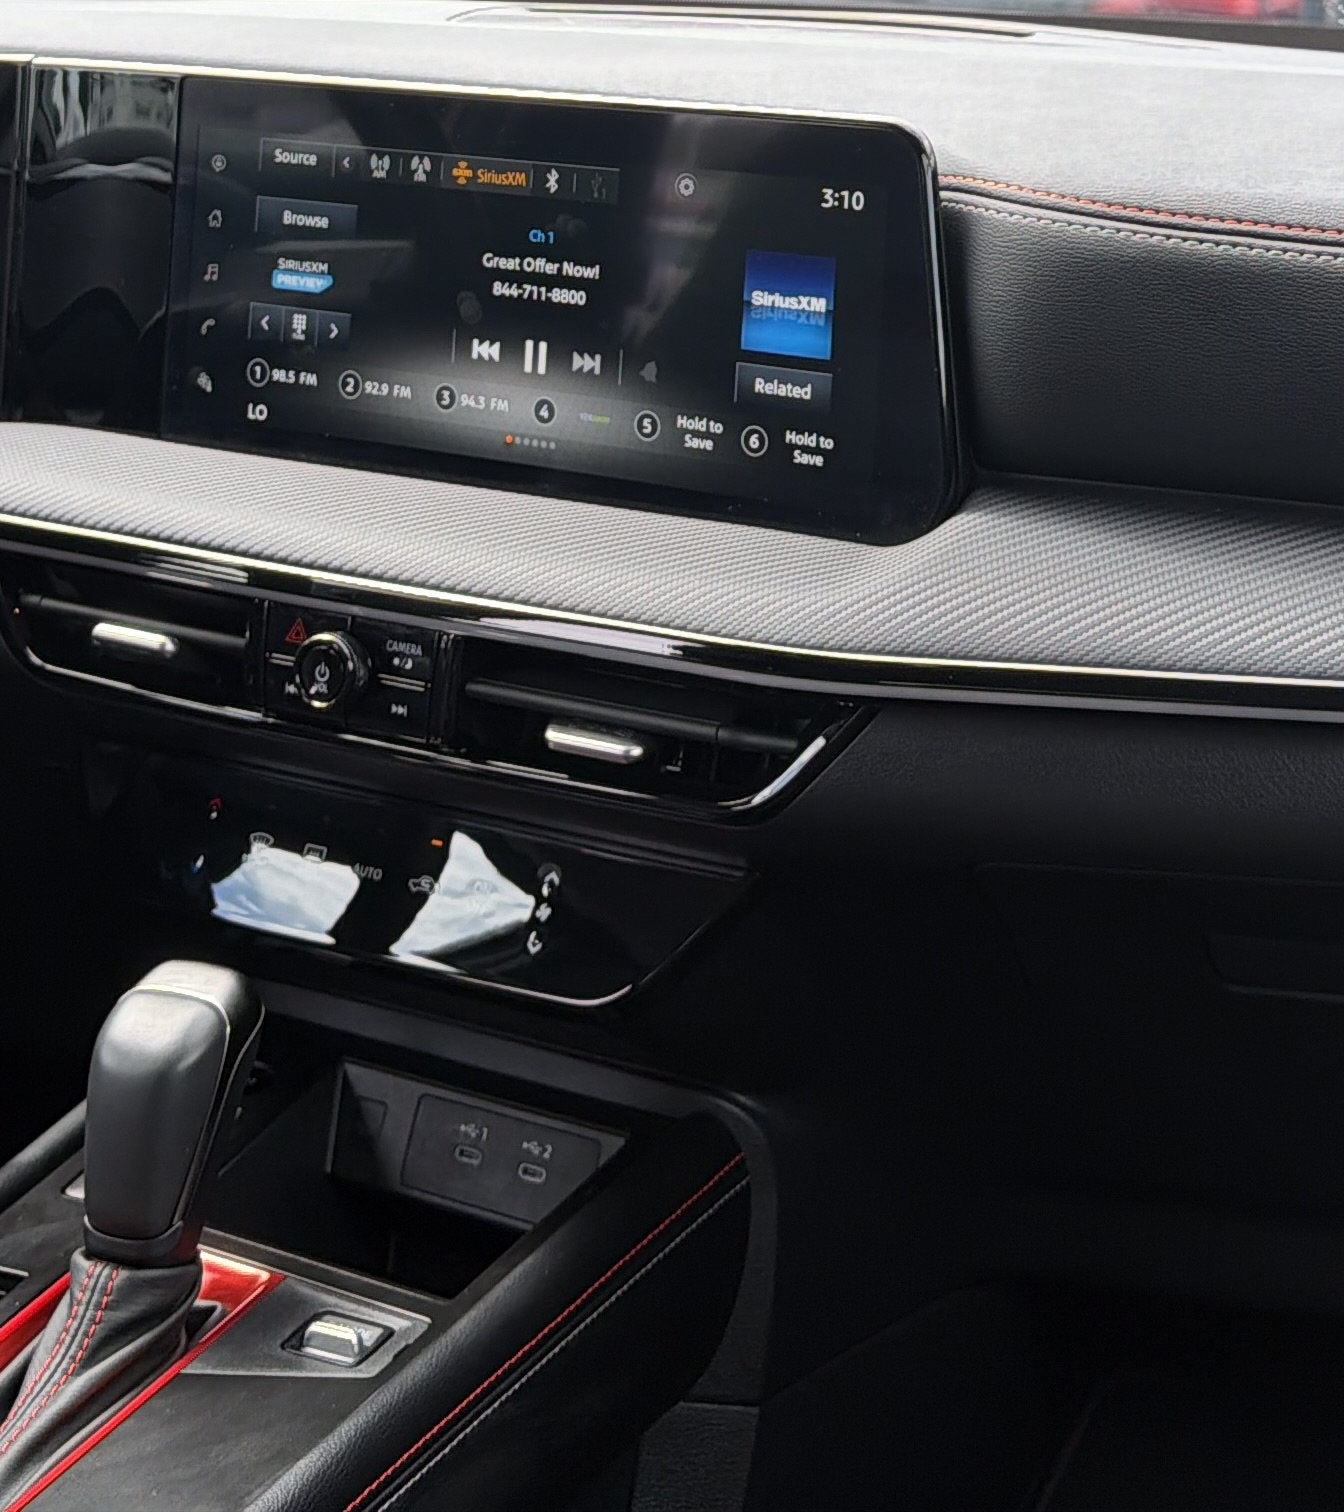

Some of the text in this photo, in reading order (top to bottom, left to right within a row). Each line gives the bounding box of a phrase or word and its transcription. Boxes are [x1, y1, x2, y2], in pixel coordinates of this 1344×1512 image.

[273, 148, 317, 166] Source
[477, 168, 527, 187] SiriusXM
[820, 187, 865, 211] 3:10
[283, 209, 329, 229] Browse
[528, 229, 554, 244] Ch 1
[277, 257, 328, 274] SIRIUSXM
[482, 252, 600, 280] Great Offer Now!
[492, 280, 587, 306] 844-711-8800
[750, 290, 827, 313] SiriusXM
[271, 368, 295, 384] 98.5
[299, 371, 318, 387] FM
[345, 377, 412, 400] 2 92.9 FM
[754, 377, 812, 401] Related
[441, 390, 509, 413] 3 94.3 FM
[247, 403, 268, 420] LO
[539, 404, 550, 419] 4
[643, 418, 652, 434] 5
[676, 414, 724, 434] Hold to
[684, 434, 714, 451] Save
[749, 433, 760, 449] 6
[785, 430, 834, 450] Hold to
[793, 450, 824, 466] Save
[386, 639, 422, 656] CAMERA
[481, 1127, 488, 1141] 1
[543, 1144, 552, 1159] 2
